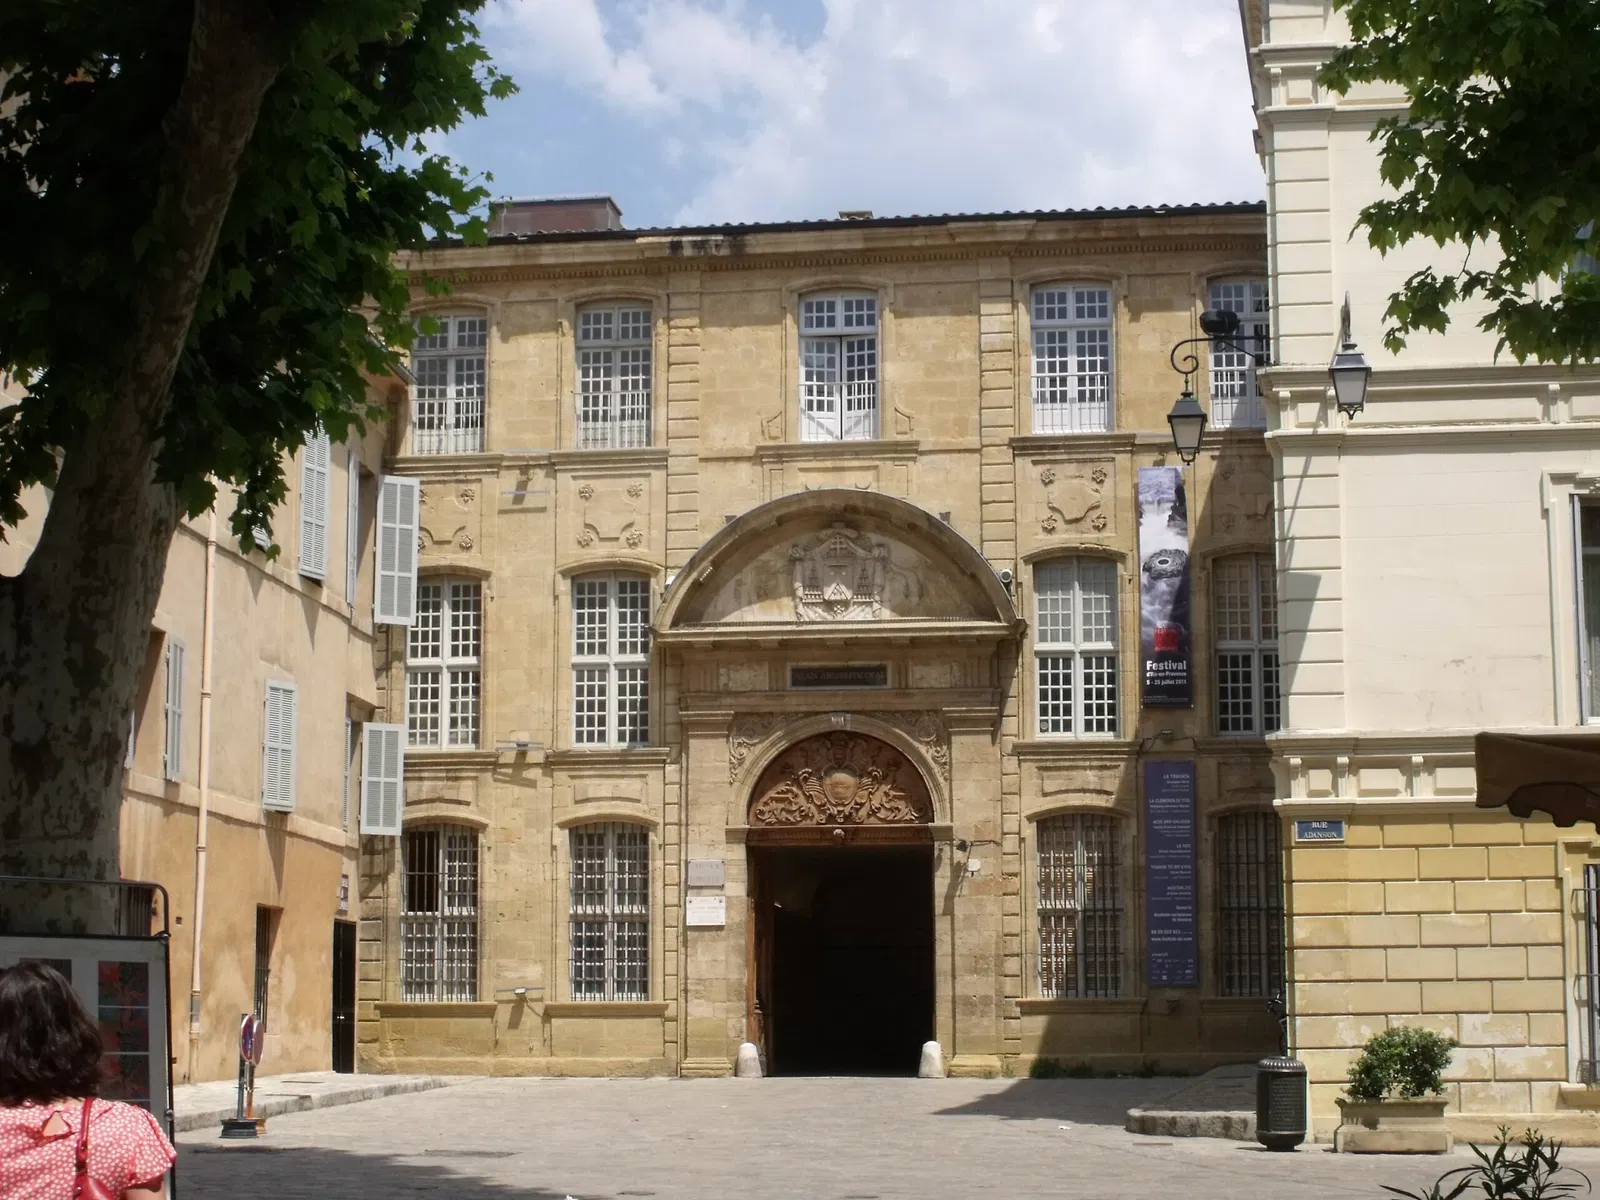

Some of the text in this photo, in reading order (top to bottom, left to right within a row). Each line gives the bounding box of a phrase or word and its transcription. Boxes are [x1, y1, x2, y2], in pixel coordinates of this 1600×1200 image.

[1146, 660, 1187, 670] Festival
[1312, 821, 1328, 829] RUE
[1303, 831, 1337, 839] ADANSON
